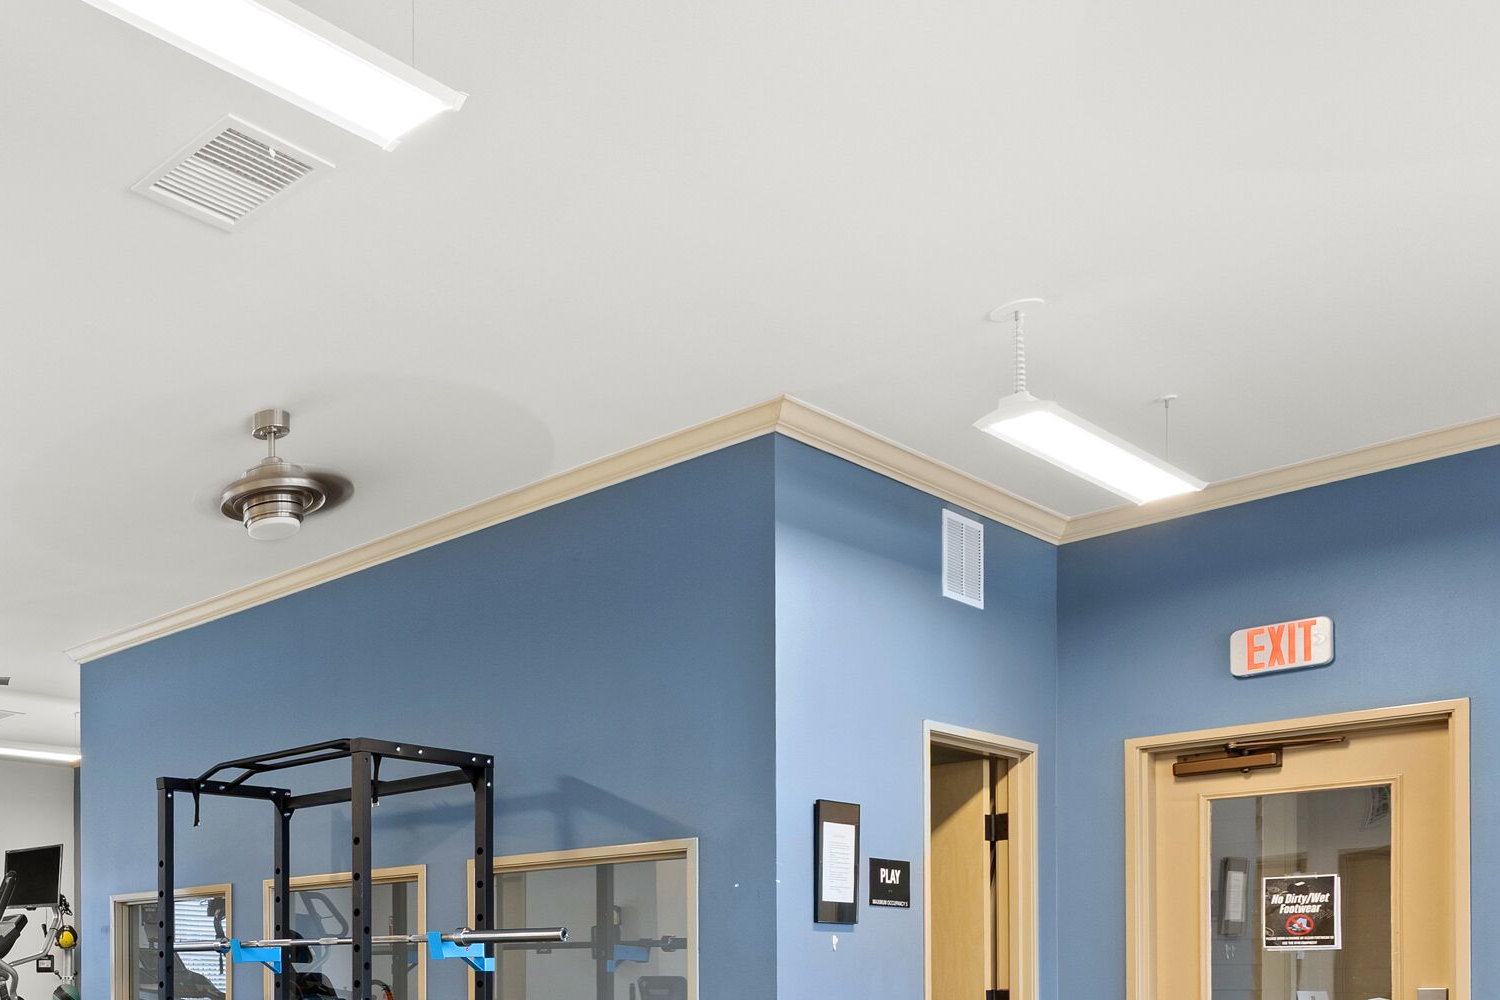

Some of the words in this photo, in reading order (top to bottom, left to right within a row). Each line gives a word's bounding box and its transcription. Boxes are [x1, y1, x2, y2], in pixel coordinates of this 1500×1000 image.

[1247, 620, 1316, 670] EXIT
[880, 868, 901, 884] PLAY
[1271, 894, 1284, 905] No
[1285, 892, 1330, 905] Dirty/Wet
[1279, 904, 1322, 914] Footwear
